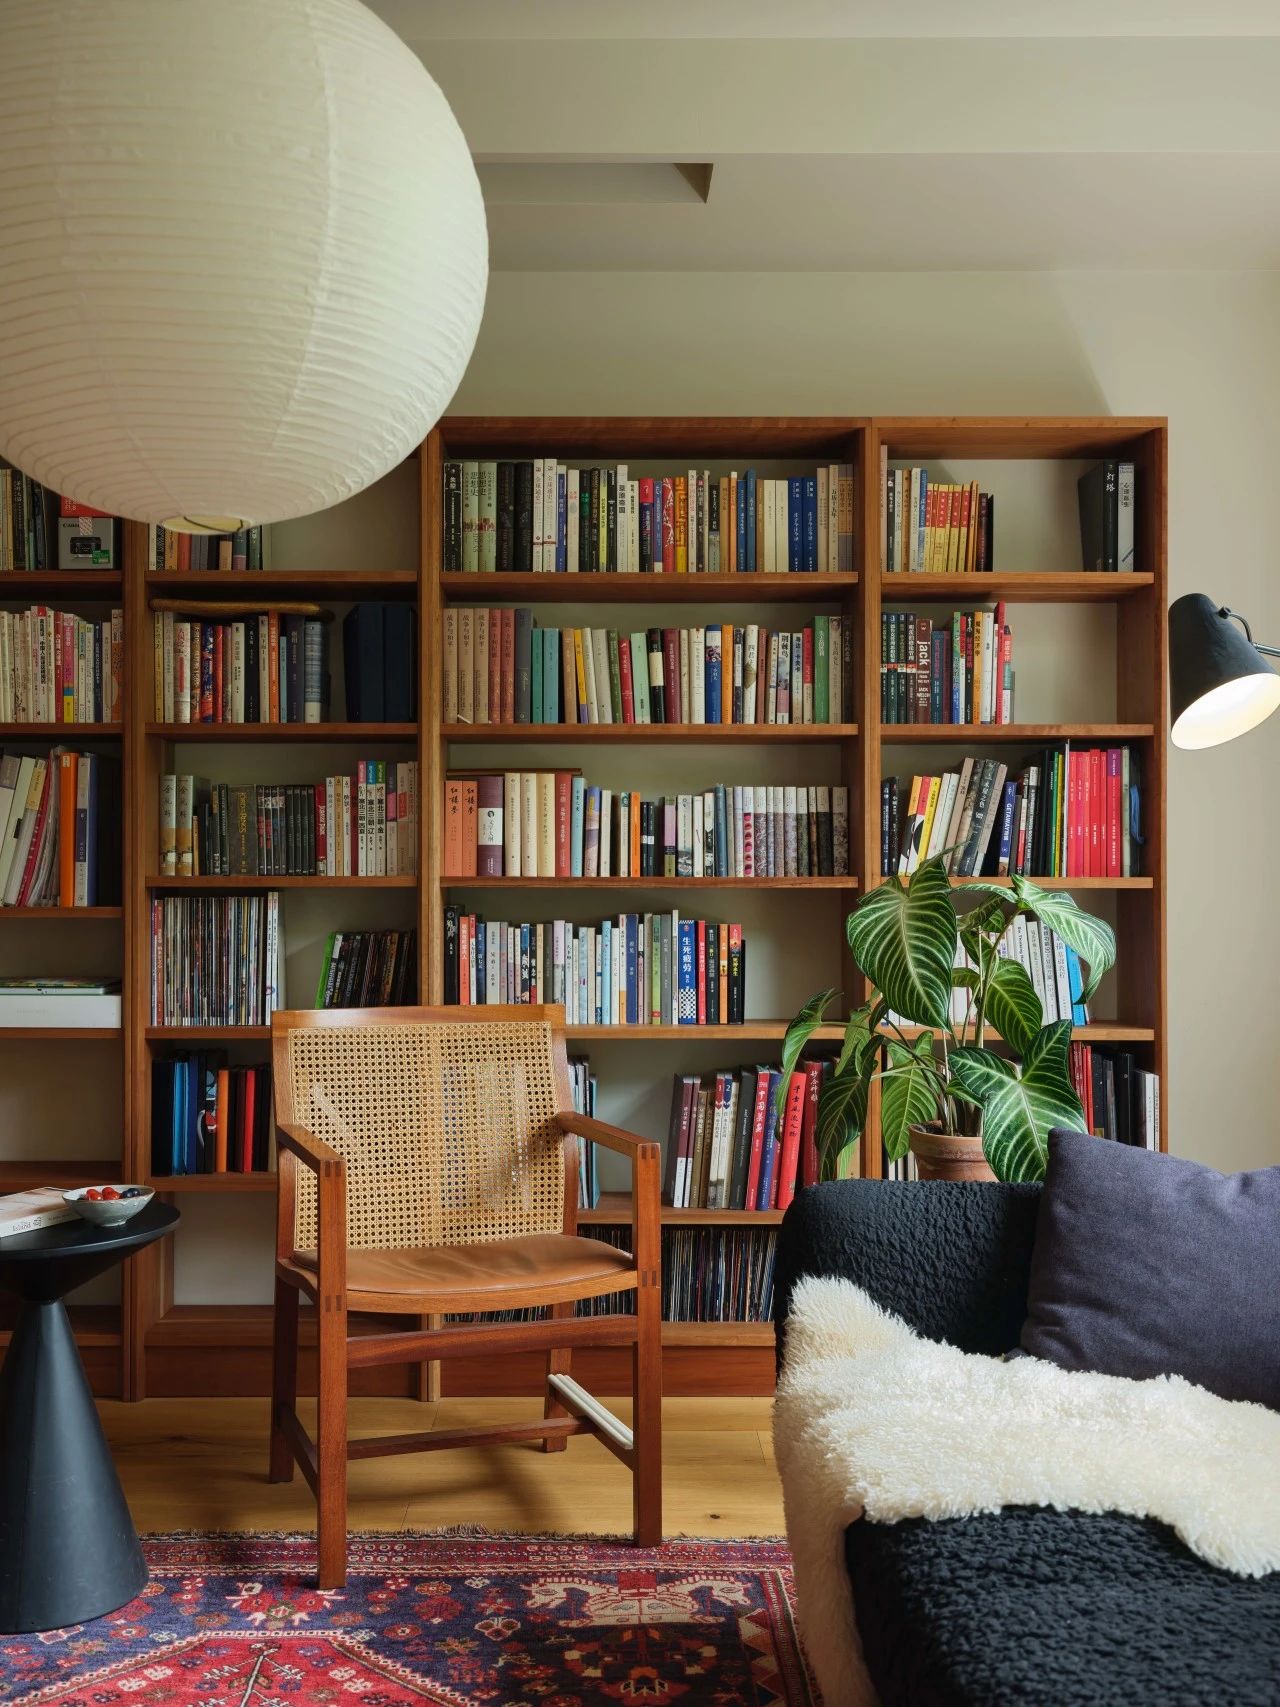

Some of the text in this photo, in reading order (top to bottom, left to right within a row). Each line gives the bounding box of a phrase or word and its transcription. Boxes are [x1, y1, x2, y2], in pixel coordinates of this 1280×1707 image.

[1106, 472, 1116, 492] 灯塔
[917, 640, 931, 666] jack
[682, 936, 692, 973] 生死疲劳
